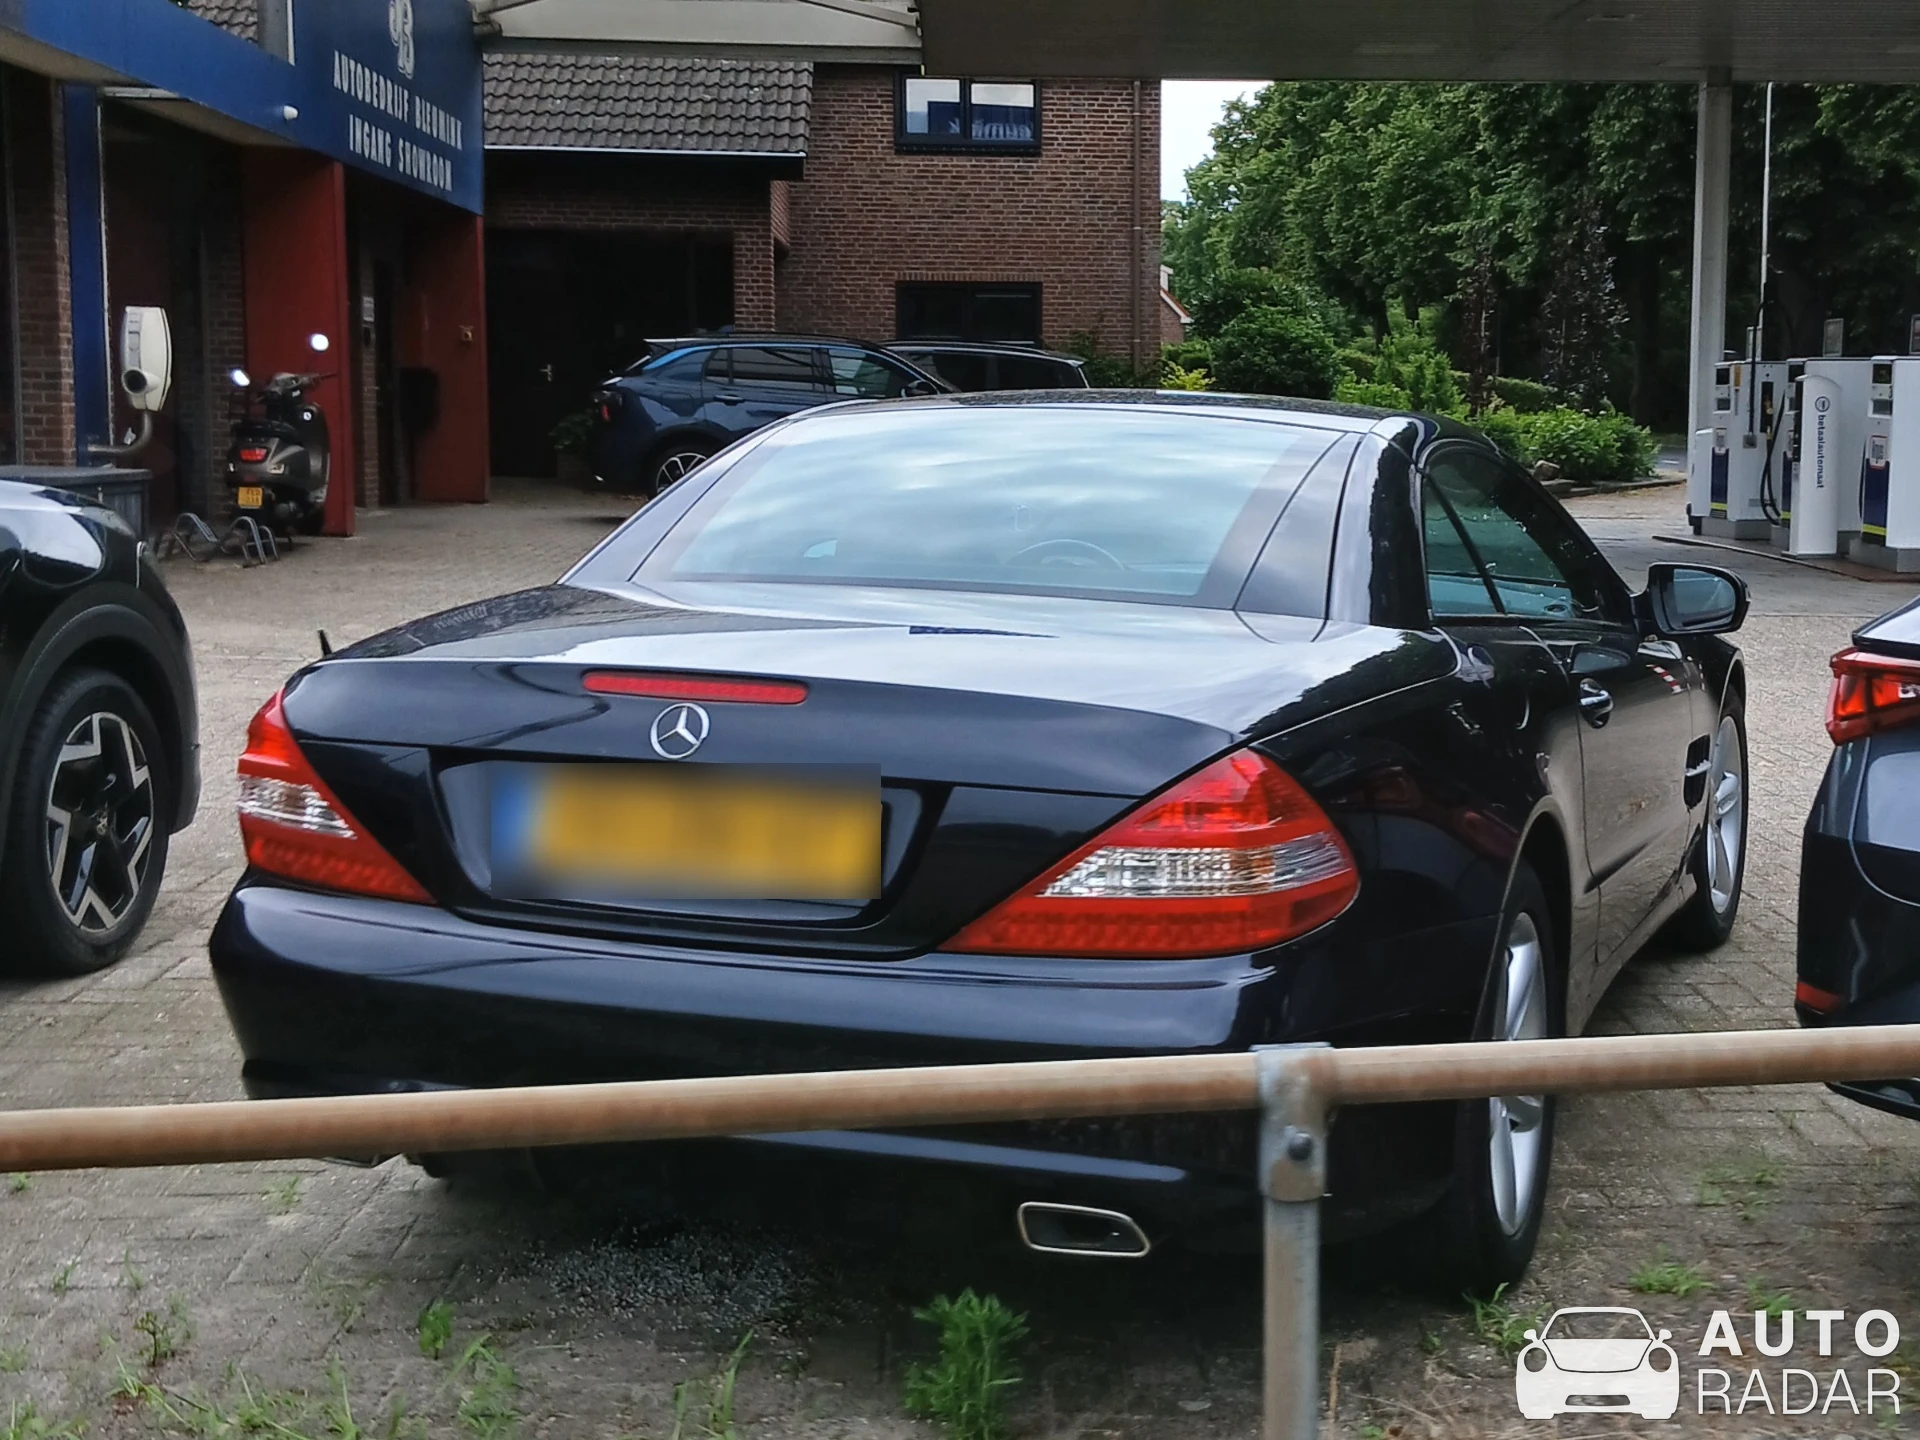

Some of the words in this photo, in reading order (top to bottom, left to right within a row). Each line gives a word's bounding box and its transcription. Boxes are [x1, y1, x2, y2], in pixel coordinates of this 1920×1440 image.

[334, 50, 409, 122] AUTOBEDRIJF
[349, 115, 392, 167] INGANG
[399, 138, 452, 191] SHOWROOM
[1817, 415, 1826, 488] betaalautomaat
